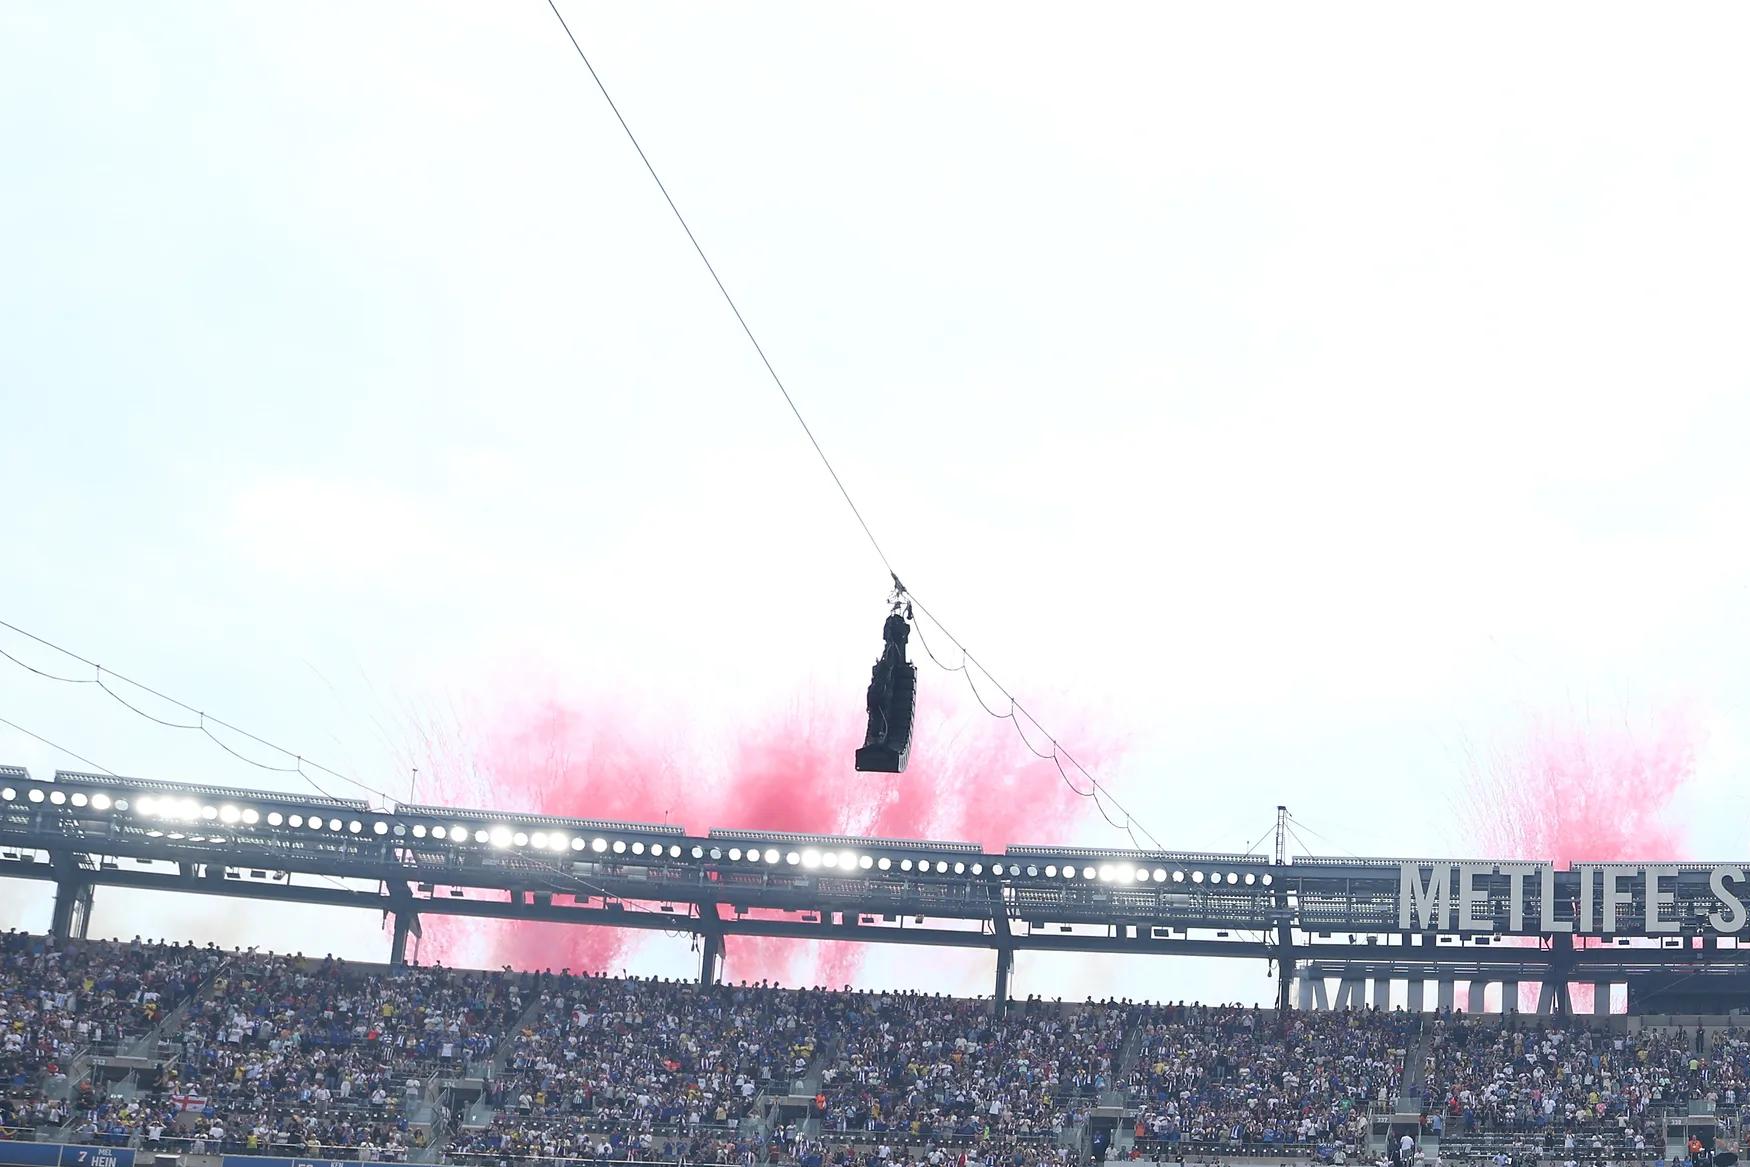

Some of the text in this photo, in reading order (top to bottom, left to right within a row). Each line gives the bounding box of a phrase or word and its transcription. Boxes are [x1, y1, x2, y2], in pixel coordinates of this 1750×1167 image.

[1399, 862, 1680, 932] METLIFE
[77, 1151, 88, 1162] 7
[98, 1148, 113, 1156] MEL
[91, 1157, 117, 1167] HEIN
